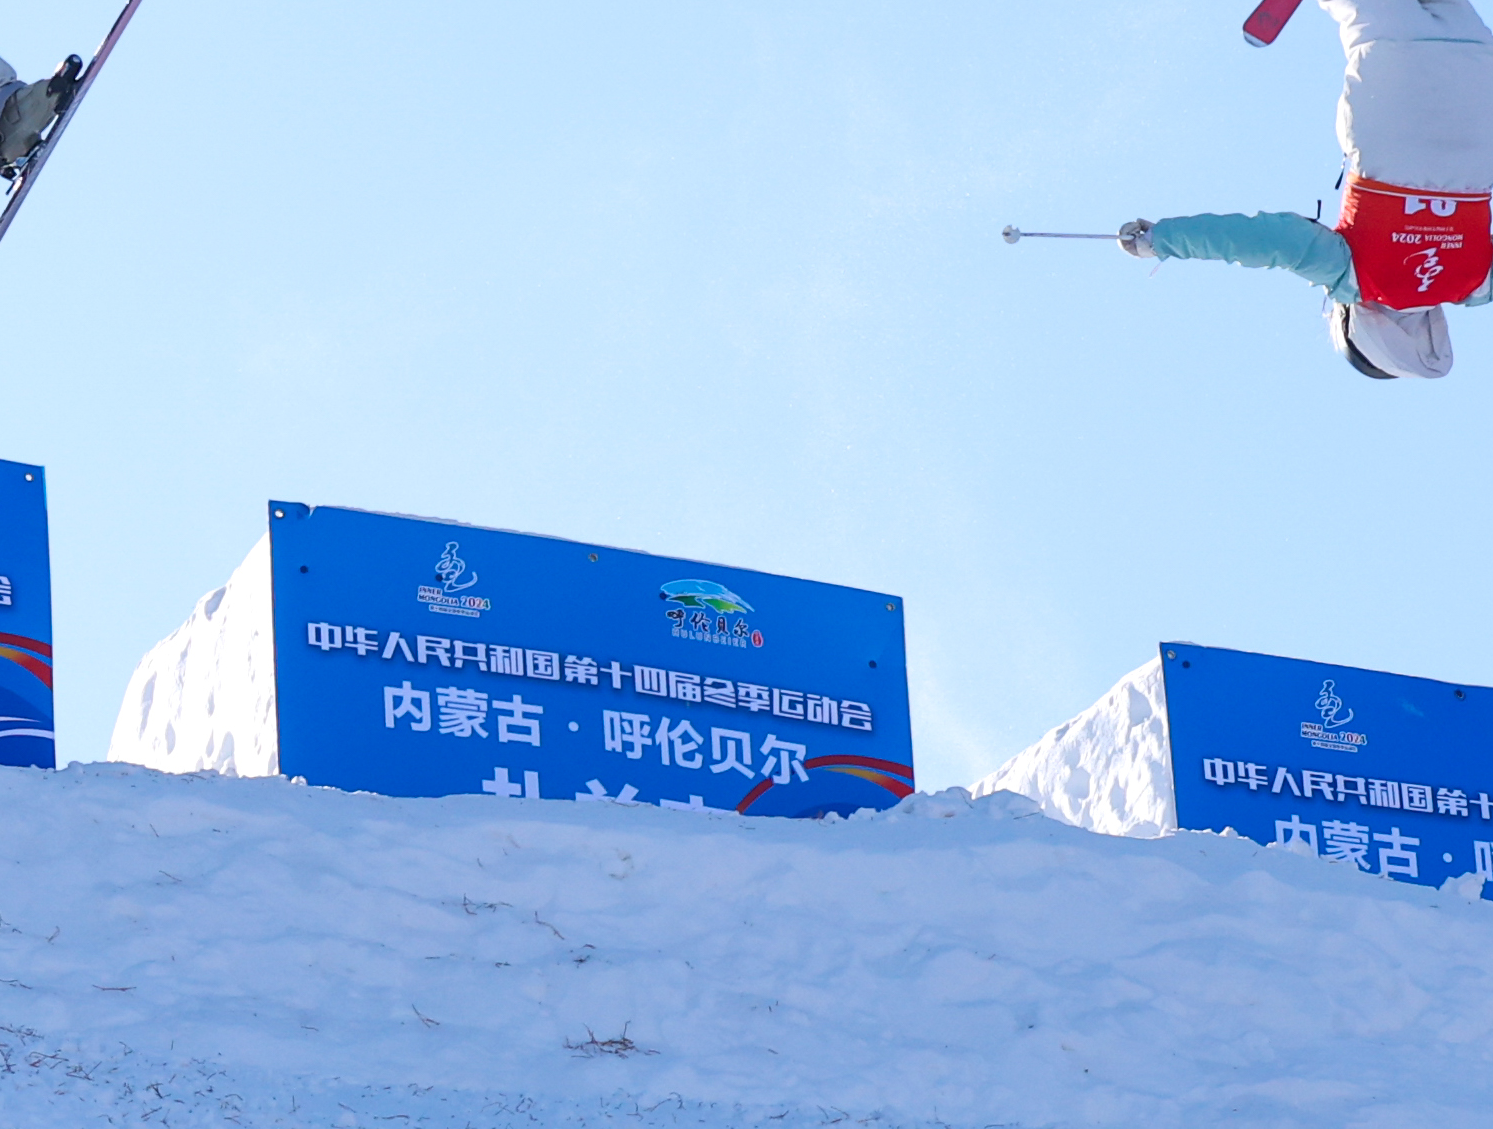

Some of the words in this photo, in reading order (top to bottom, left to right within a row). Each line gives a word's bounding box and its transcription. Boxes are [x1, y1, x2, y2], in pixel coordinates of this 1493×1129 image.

[1391, 232, 1422, 245] 2024
[417, 593, 459, 606] MONGOLIA
[460, 595, 491, 610] 2024
[307, 622, 873, 731] 中华人民共和国第十四届冬季运动会
[1339, 731, 1367, 745] 2024
